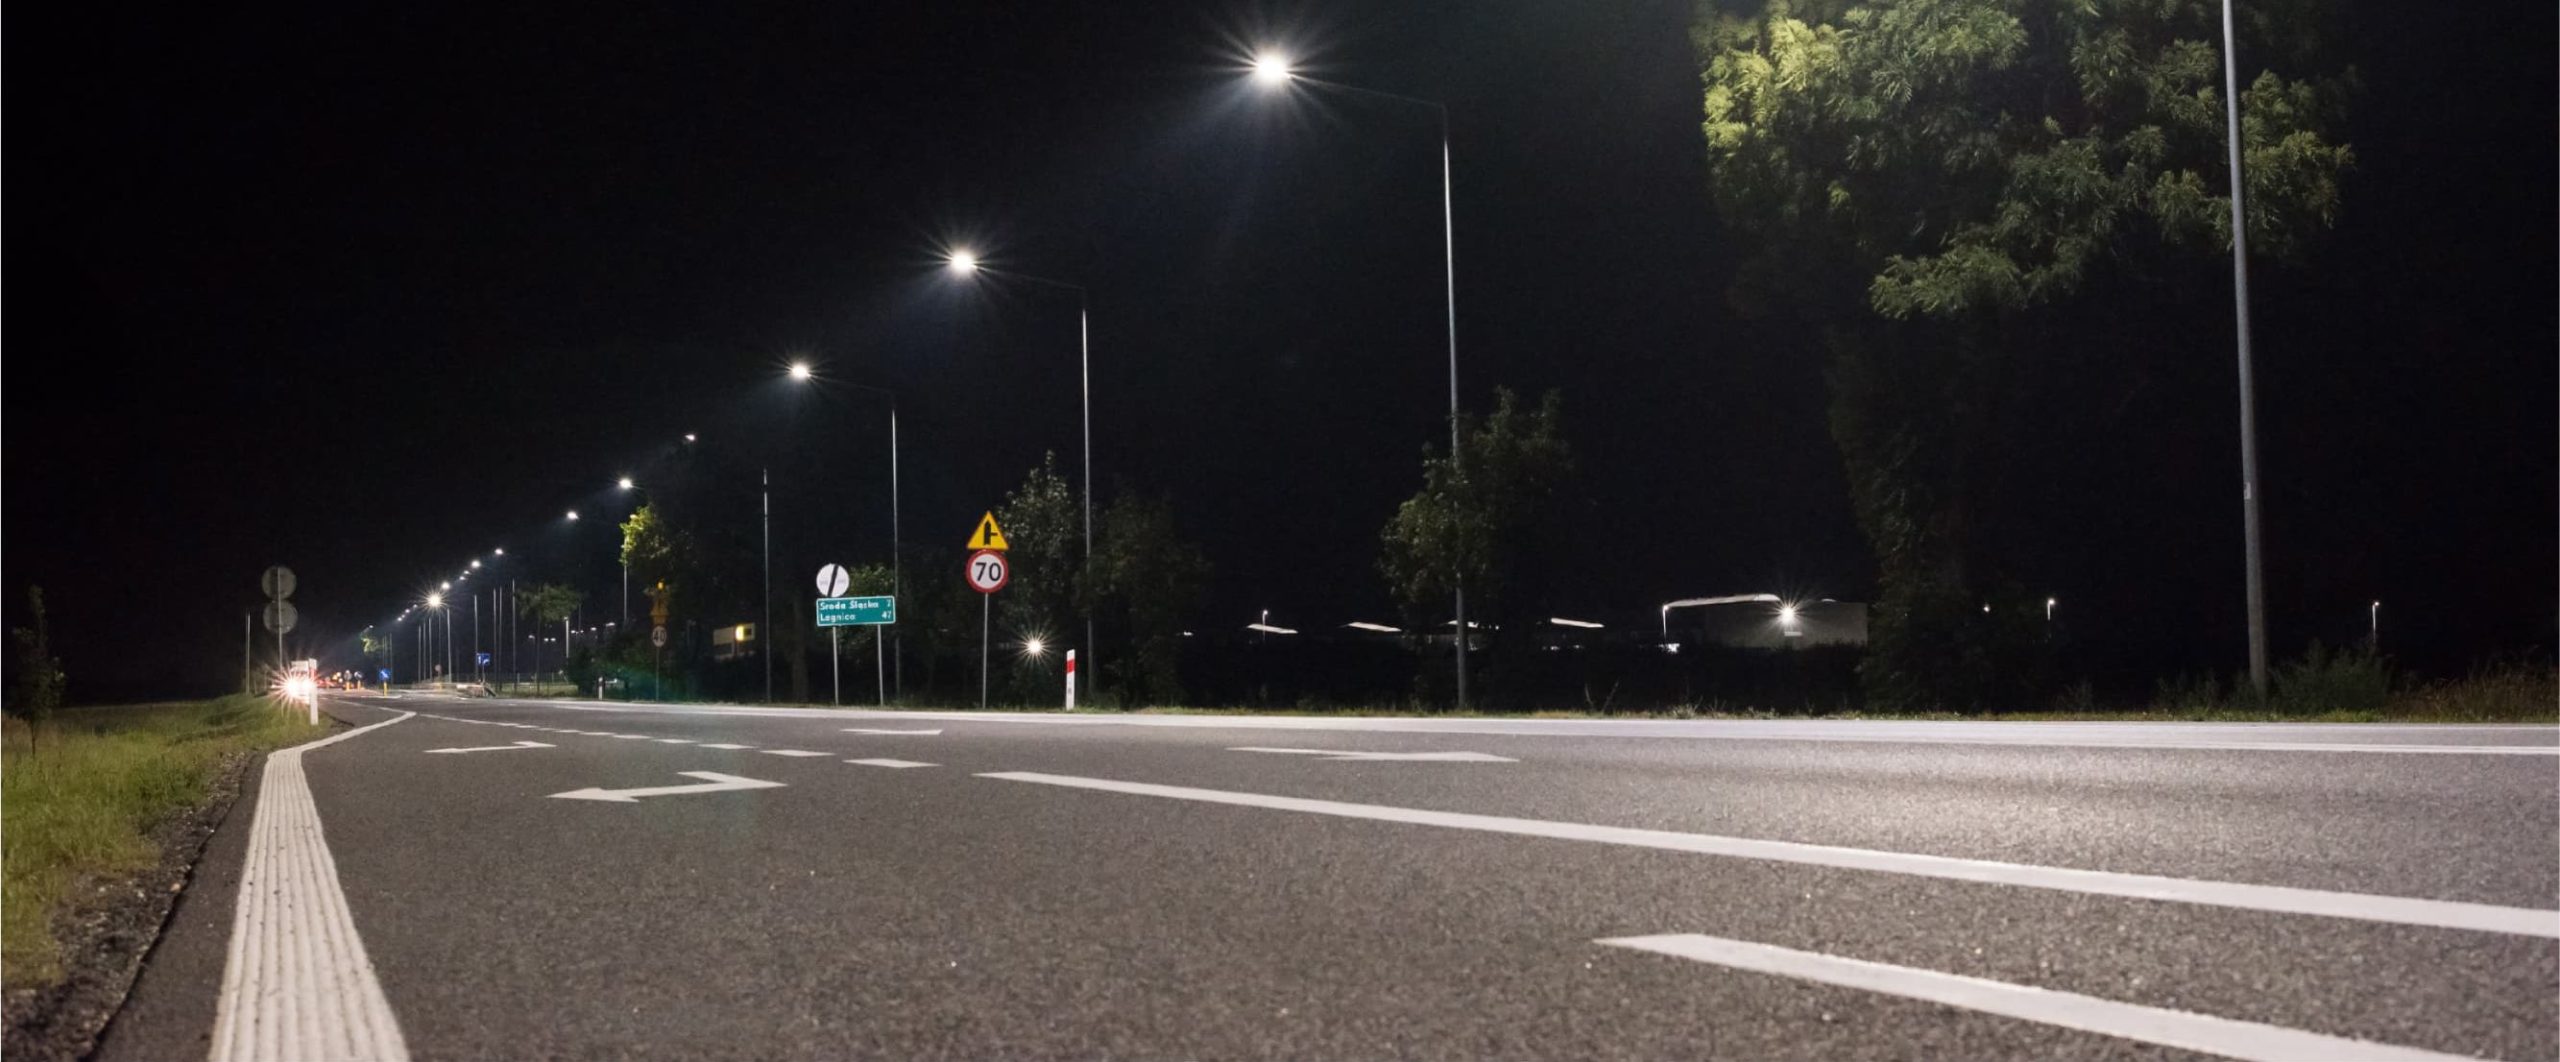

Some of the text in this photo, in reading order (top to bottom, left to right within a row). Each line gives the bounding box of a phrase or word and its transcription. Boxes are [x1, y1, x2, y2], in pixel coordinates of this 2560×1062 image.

[975, 562, 1002, 581] 70
[820, 611, 892, 622] Legnica 47
